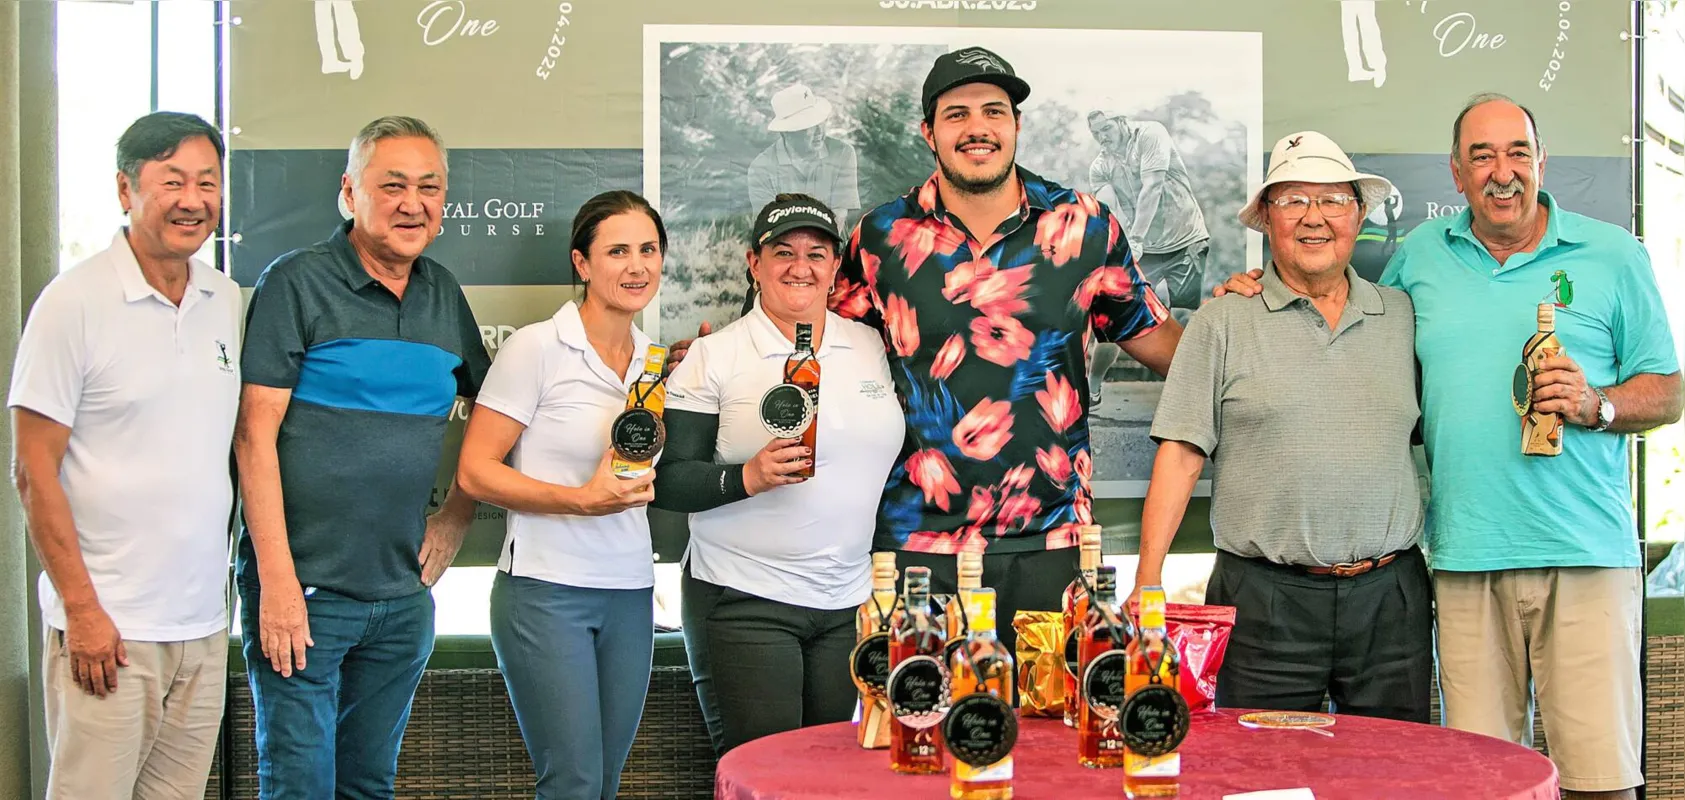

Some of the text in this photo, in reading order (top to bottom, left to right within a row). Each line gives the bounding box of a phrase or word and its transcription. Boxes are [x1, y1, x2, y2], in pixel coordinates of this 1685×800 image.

[416, 0, 500, 46] One
[535, 2, 572, 81] 04.2023
[1433, 12, 1507, 57] One
[1538, 1, 1571, 92] 0.04.2023
[442, 198, 545, 219] YAL GOLF
[767, 205, 833, 224] TaylorMade
[1426, 201, 1467, 220] ROY
